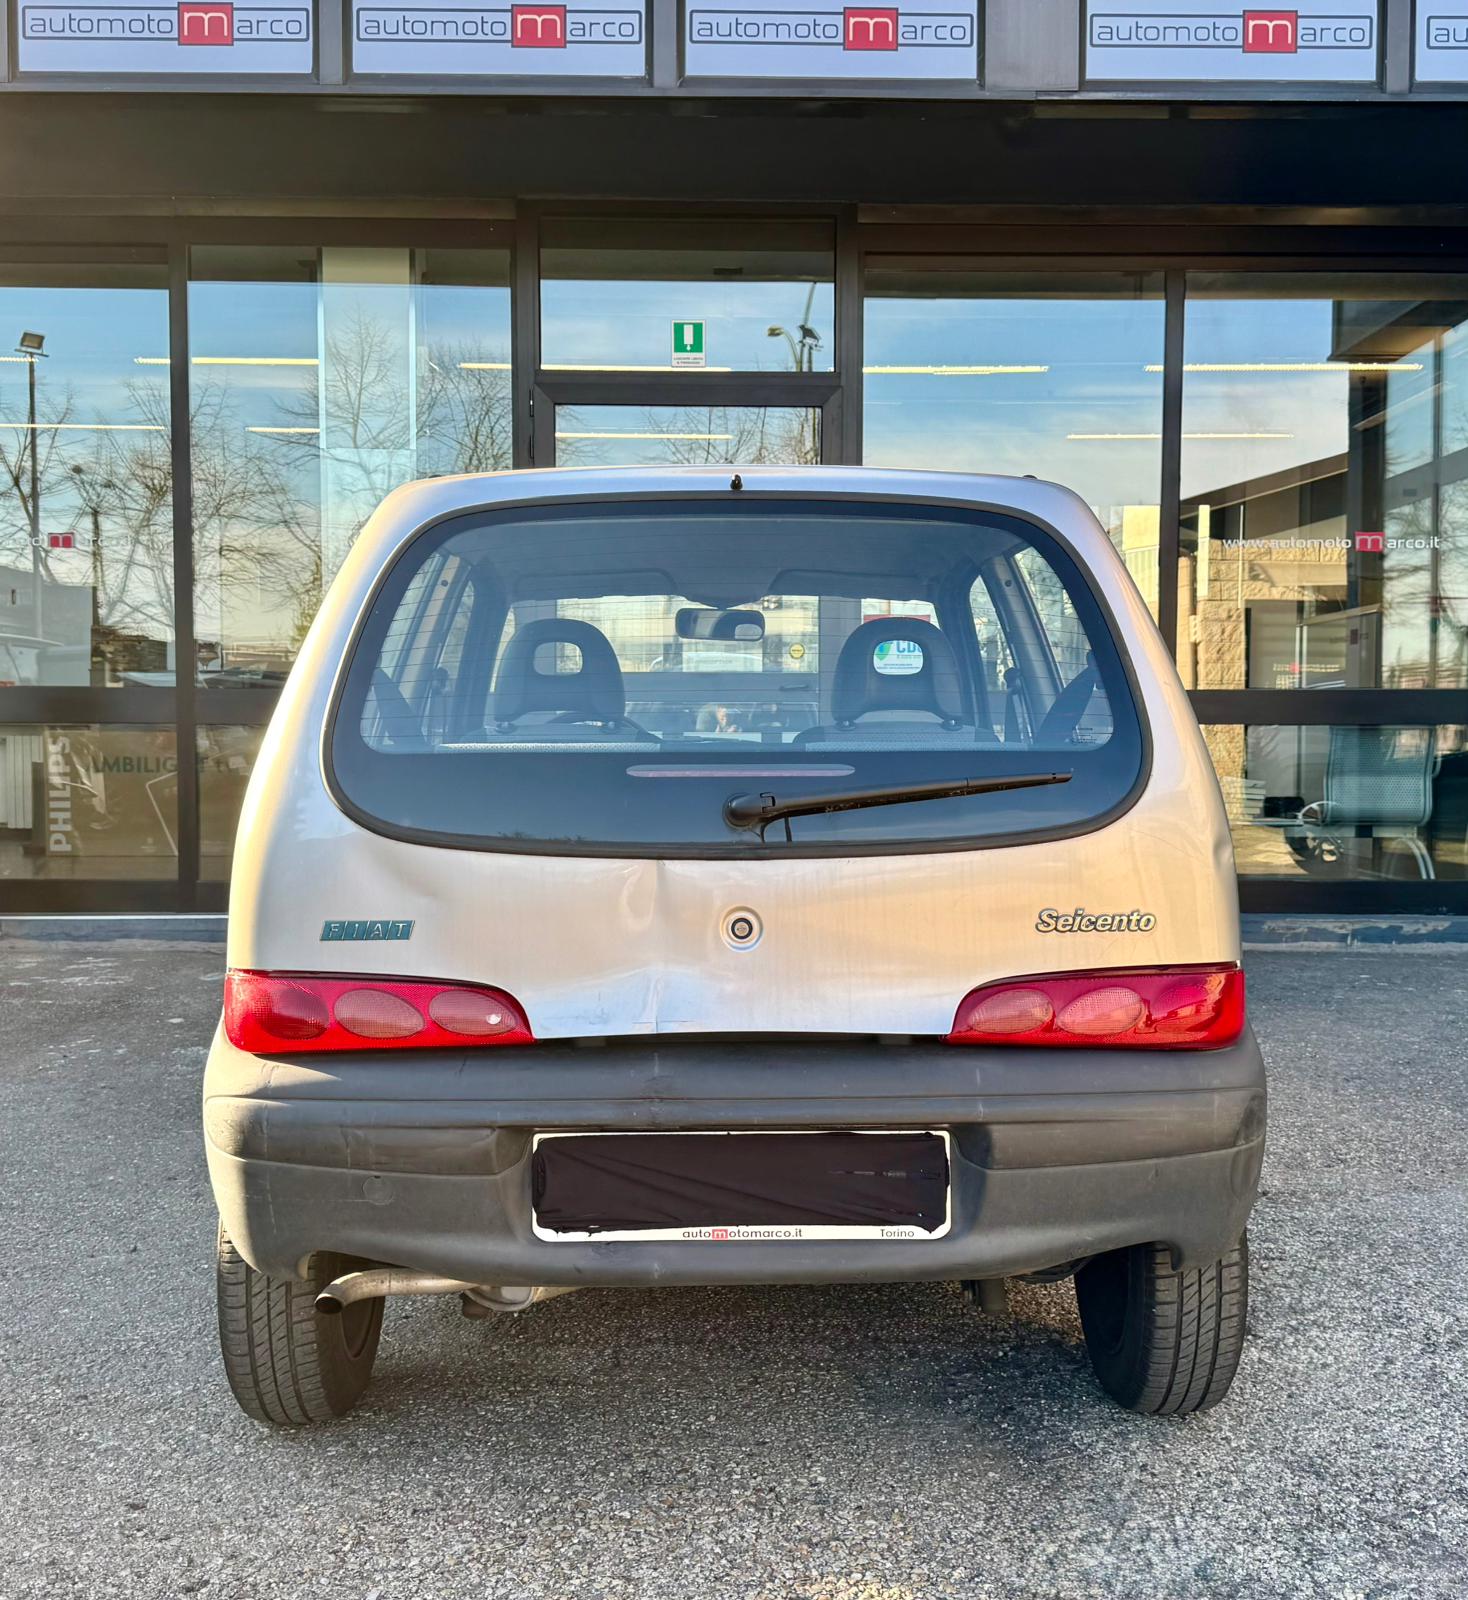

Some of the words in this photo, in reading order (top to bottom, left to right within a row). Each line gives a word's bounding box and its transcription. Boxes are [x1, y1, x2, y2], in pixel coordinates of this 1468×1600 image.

[48, 736, 72, 852] PHILIPS
[324, 921, 411, 940] FIAT
[1035, 907, 1157, 933] Seicento
[682, 1228, 803, 1239] automotomarco.it
[880, 1228, 915, 1239] Torino
